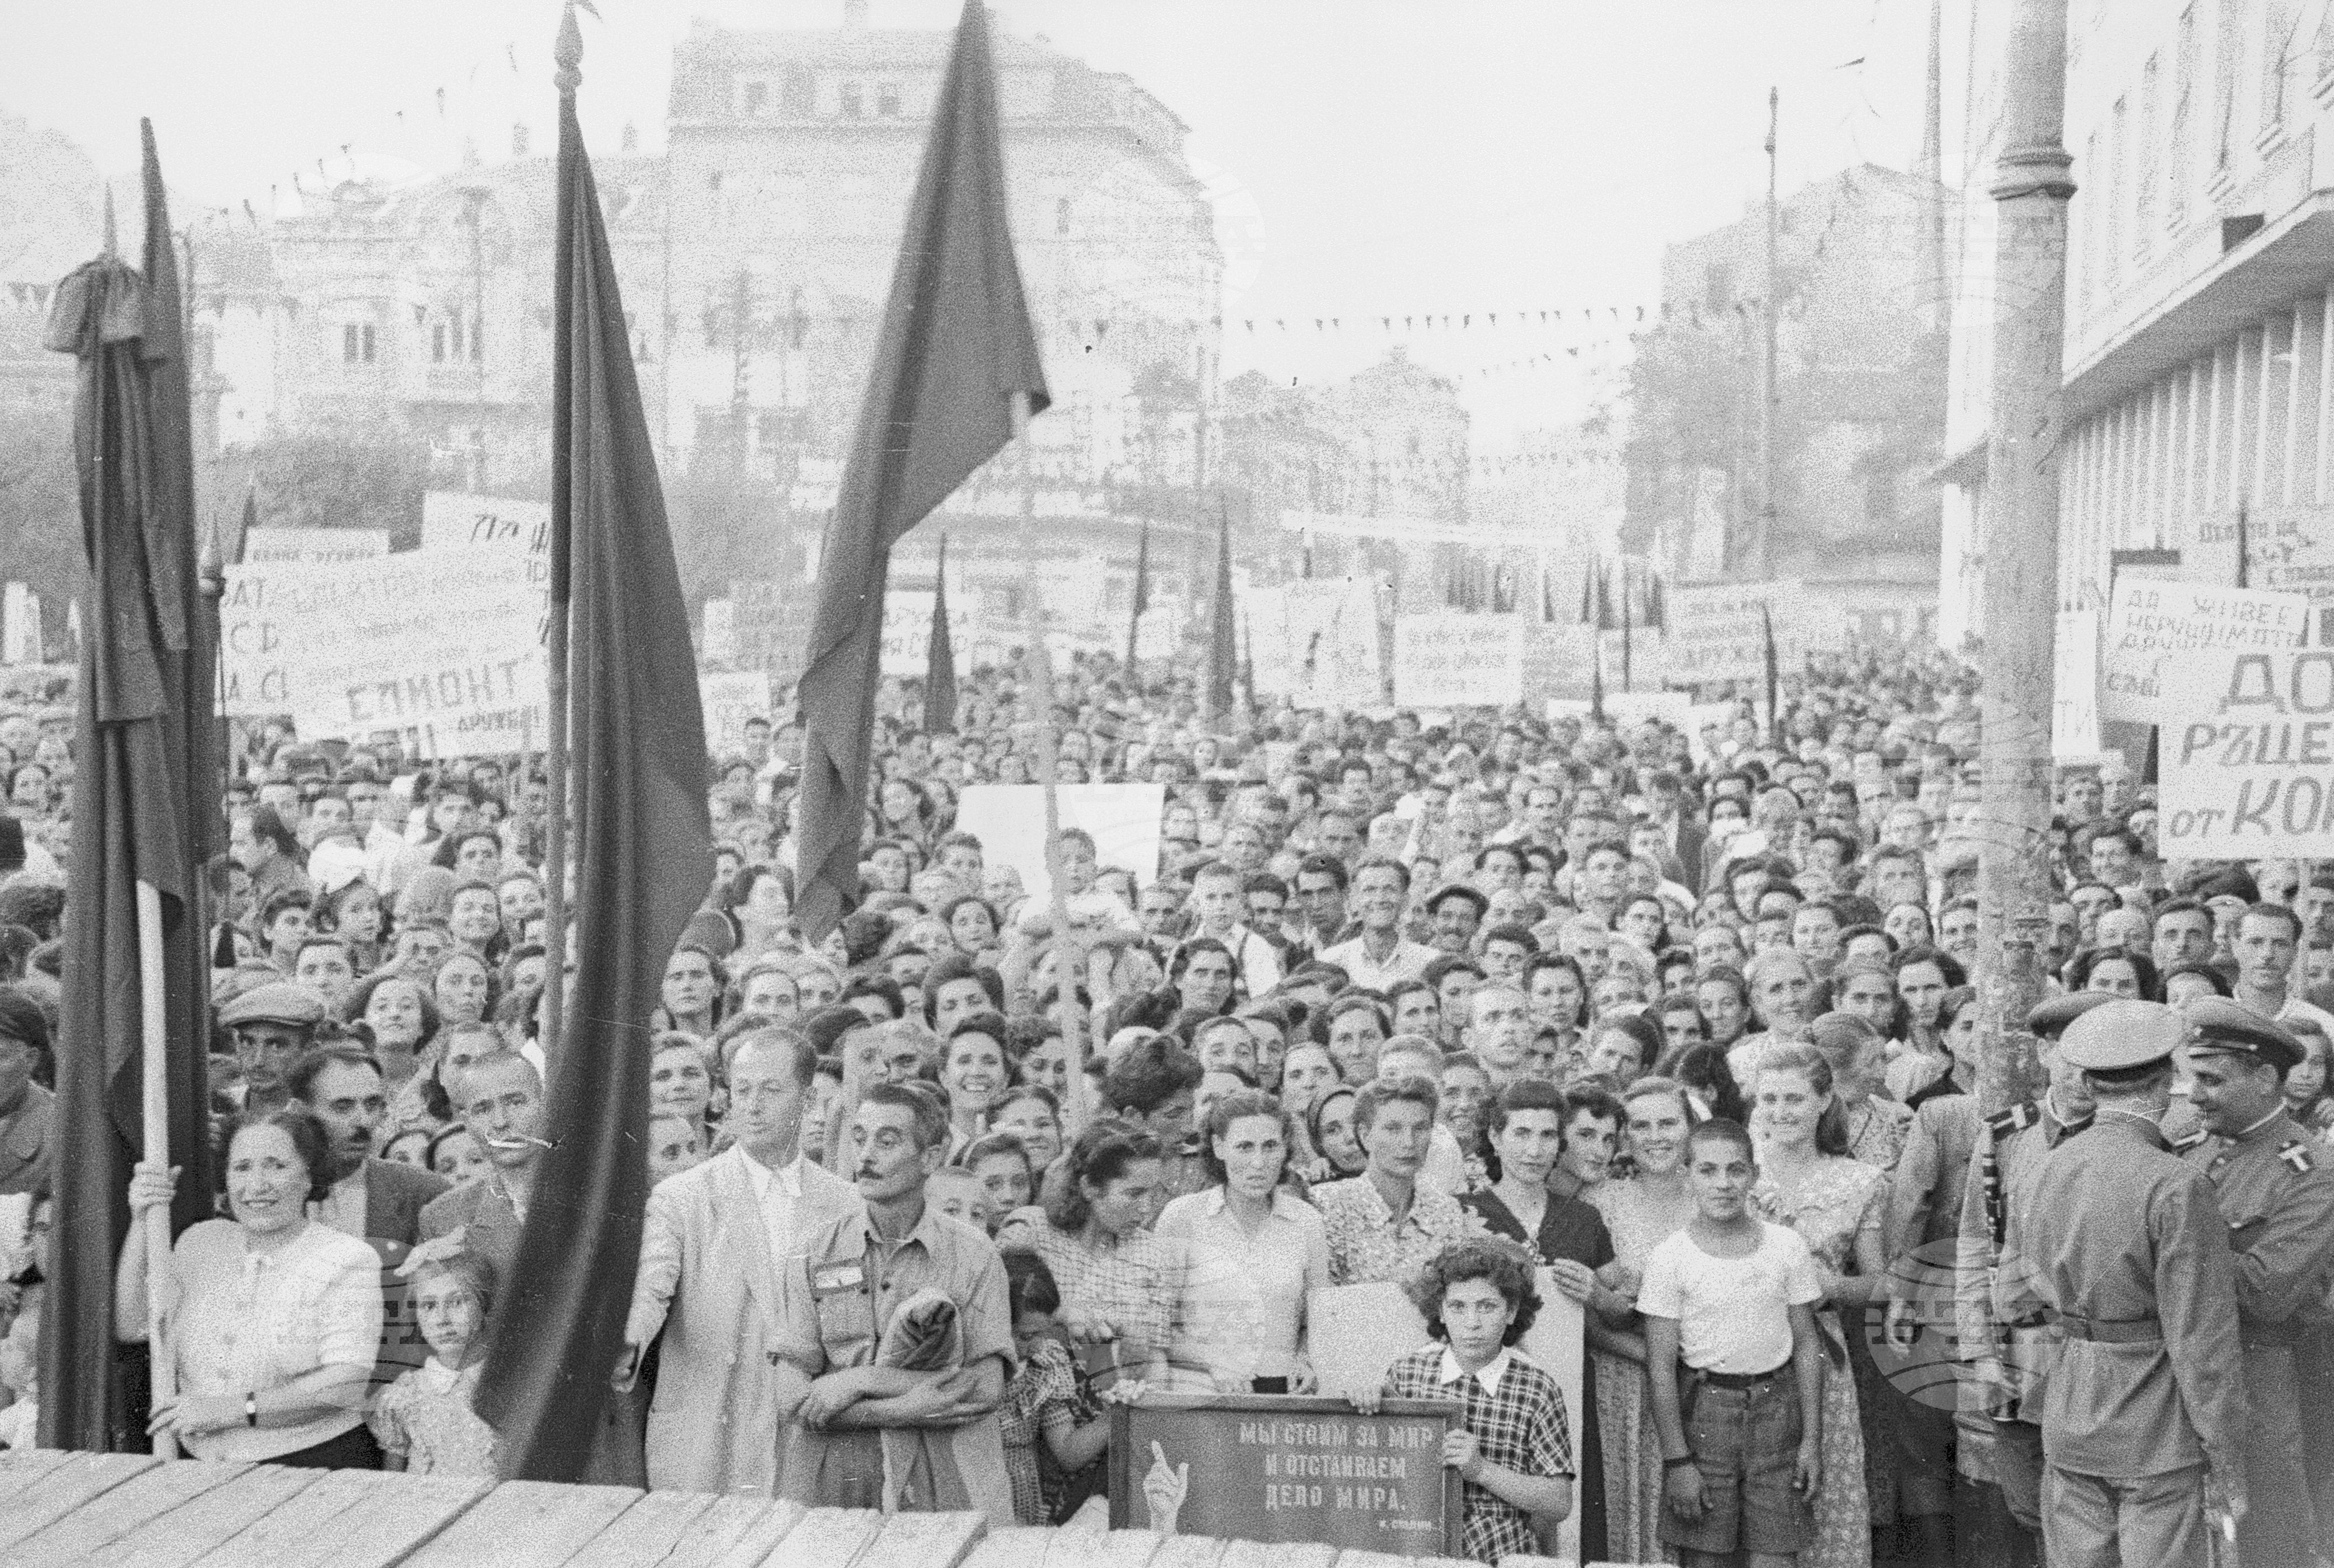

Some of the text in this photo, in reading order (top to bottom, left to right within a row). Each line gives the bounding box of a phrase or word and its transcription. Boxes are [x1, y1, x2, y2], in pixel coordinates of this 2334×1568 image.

[2127, 589, 2159, 611] ДА
[1239, 1422, 1432, 1450] МЫ СТОИМ ЗА МИР
[1265, 1453, 1406, 1479] И ОТСТАИВАЕМ
[1265, 1485, 1322, 1511] ДЕЛО
